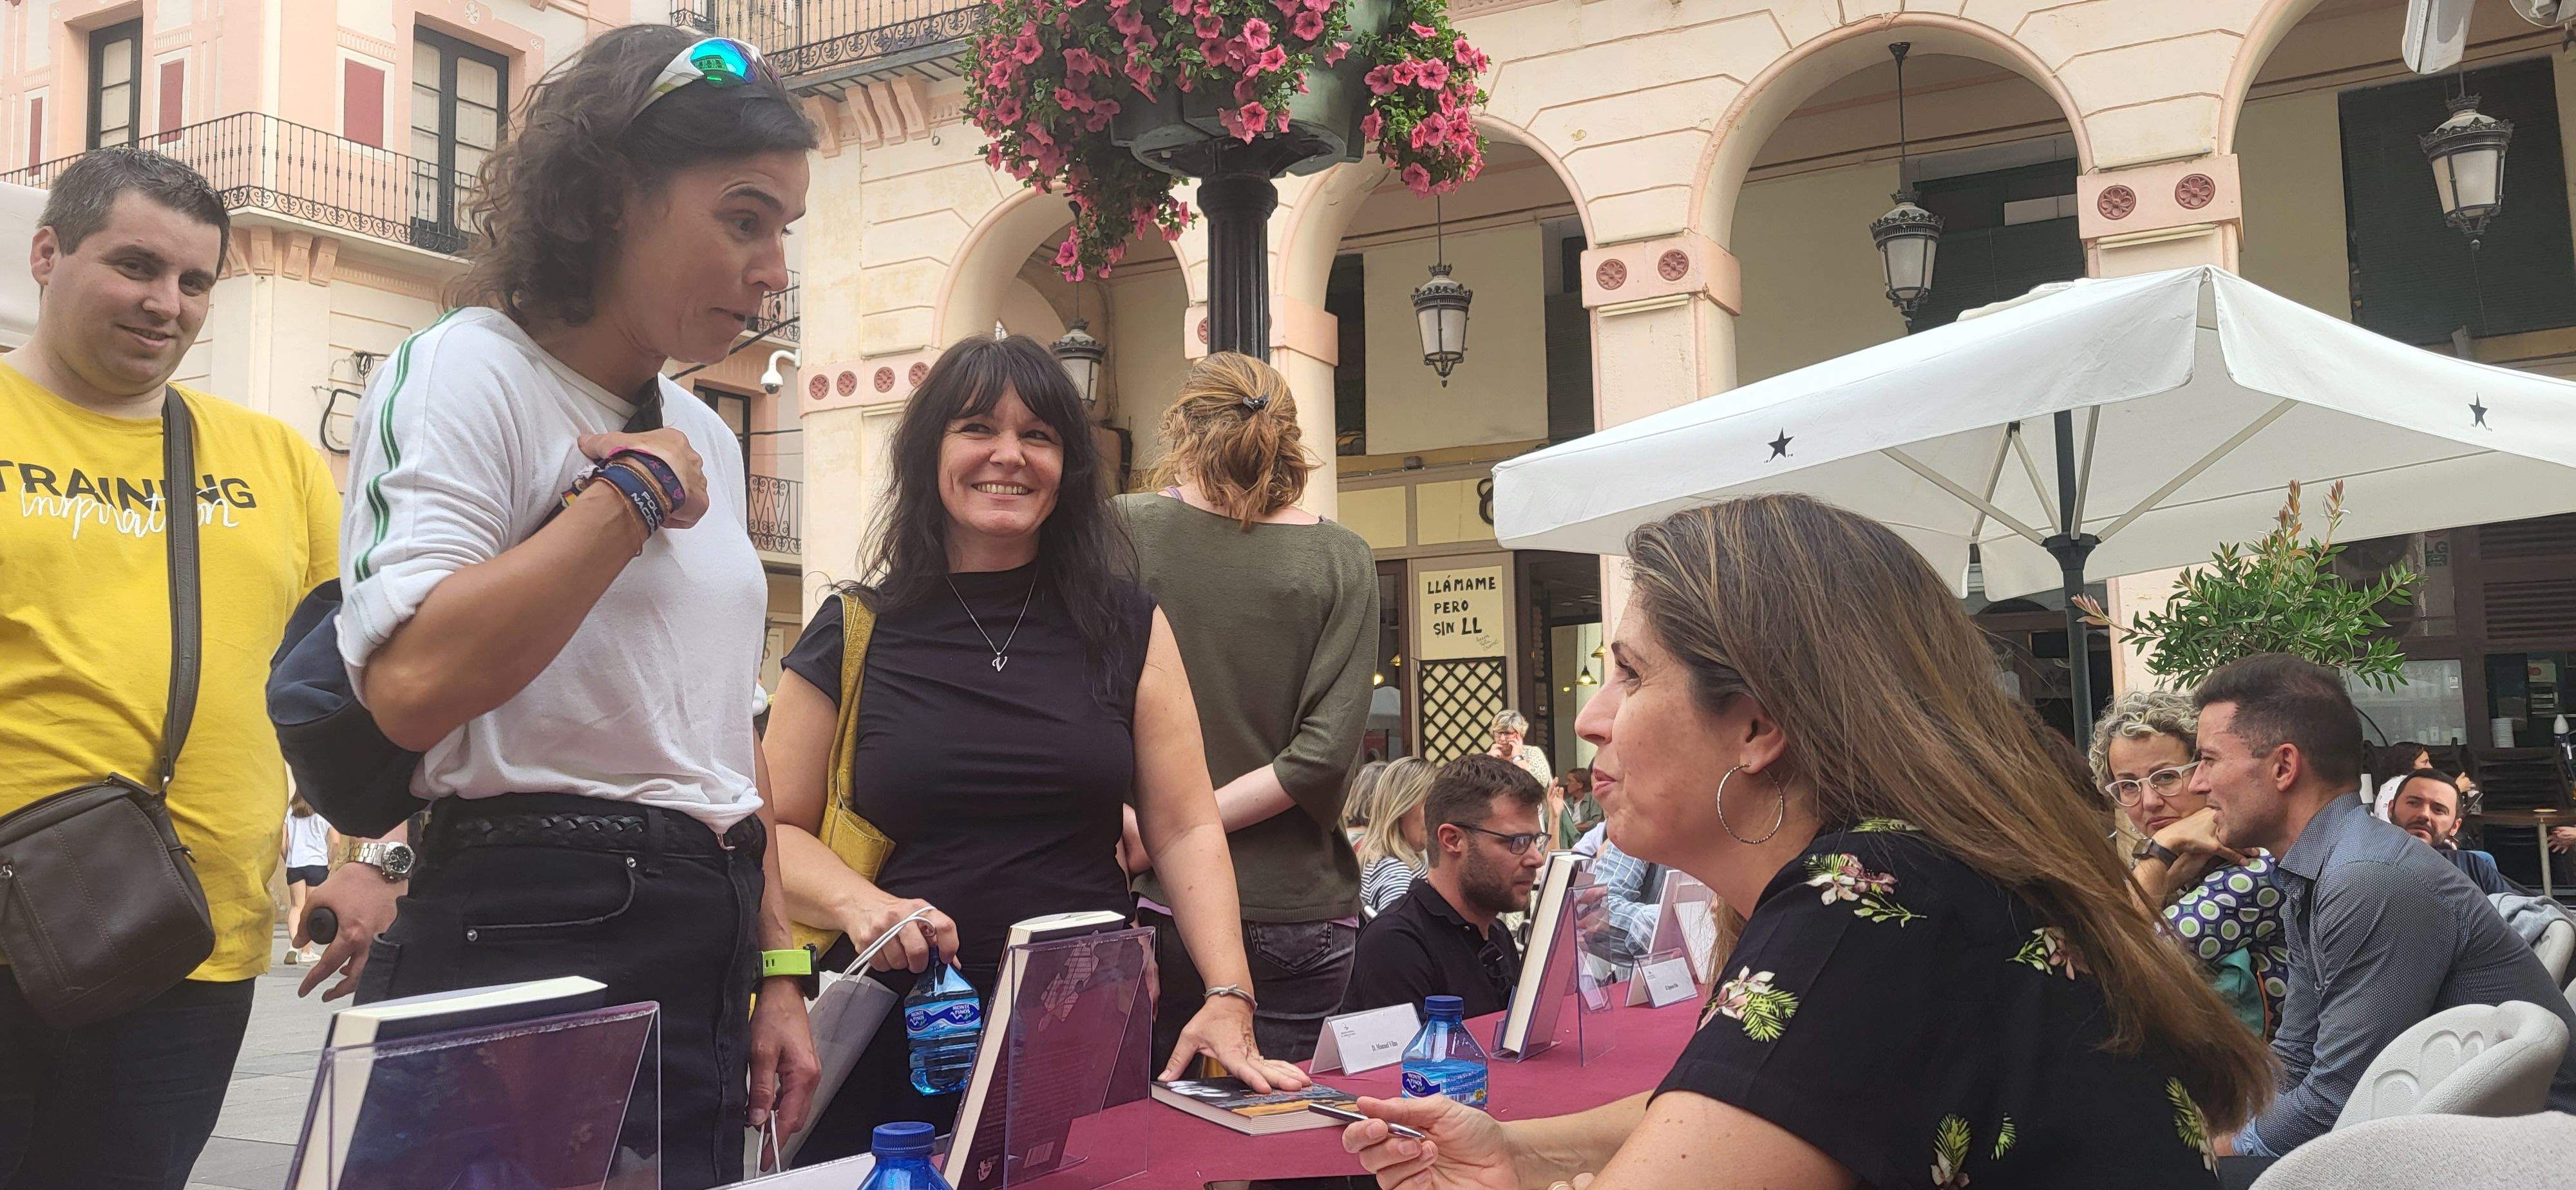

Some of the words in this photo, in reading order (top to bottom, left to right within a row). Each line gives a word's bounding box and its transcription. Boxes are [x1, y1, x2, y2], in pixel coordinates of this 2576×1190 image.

[0, 460, 257, 509] RAINNG
[21, 482, 240, 540] Inspiratn
[1427, 574, 1496, 594] LLÁMAME
[1434, 600, 1469, 614] PERO
[1433, 621, 1455, 637] SIN
[1461, 617, 1482, 636] LL
